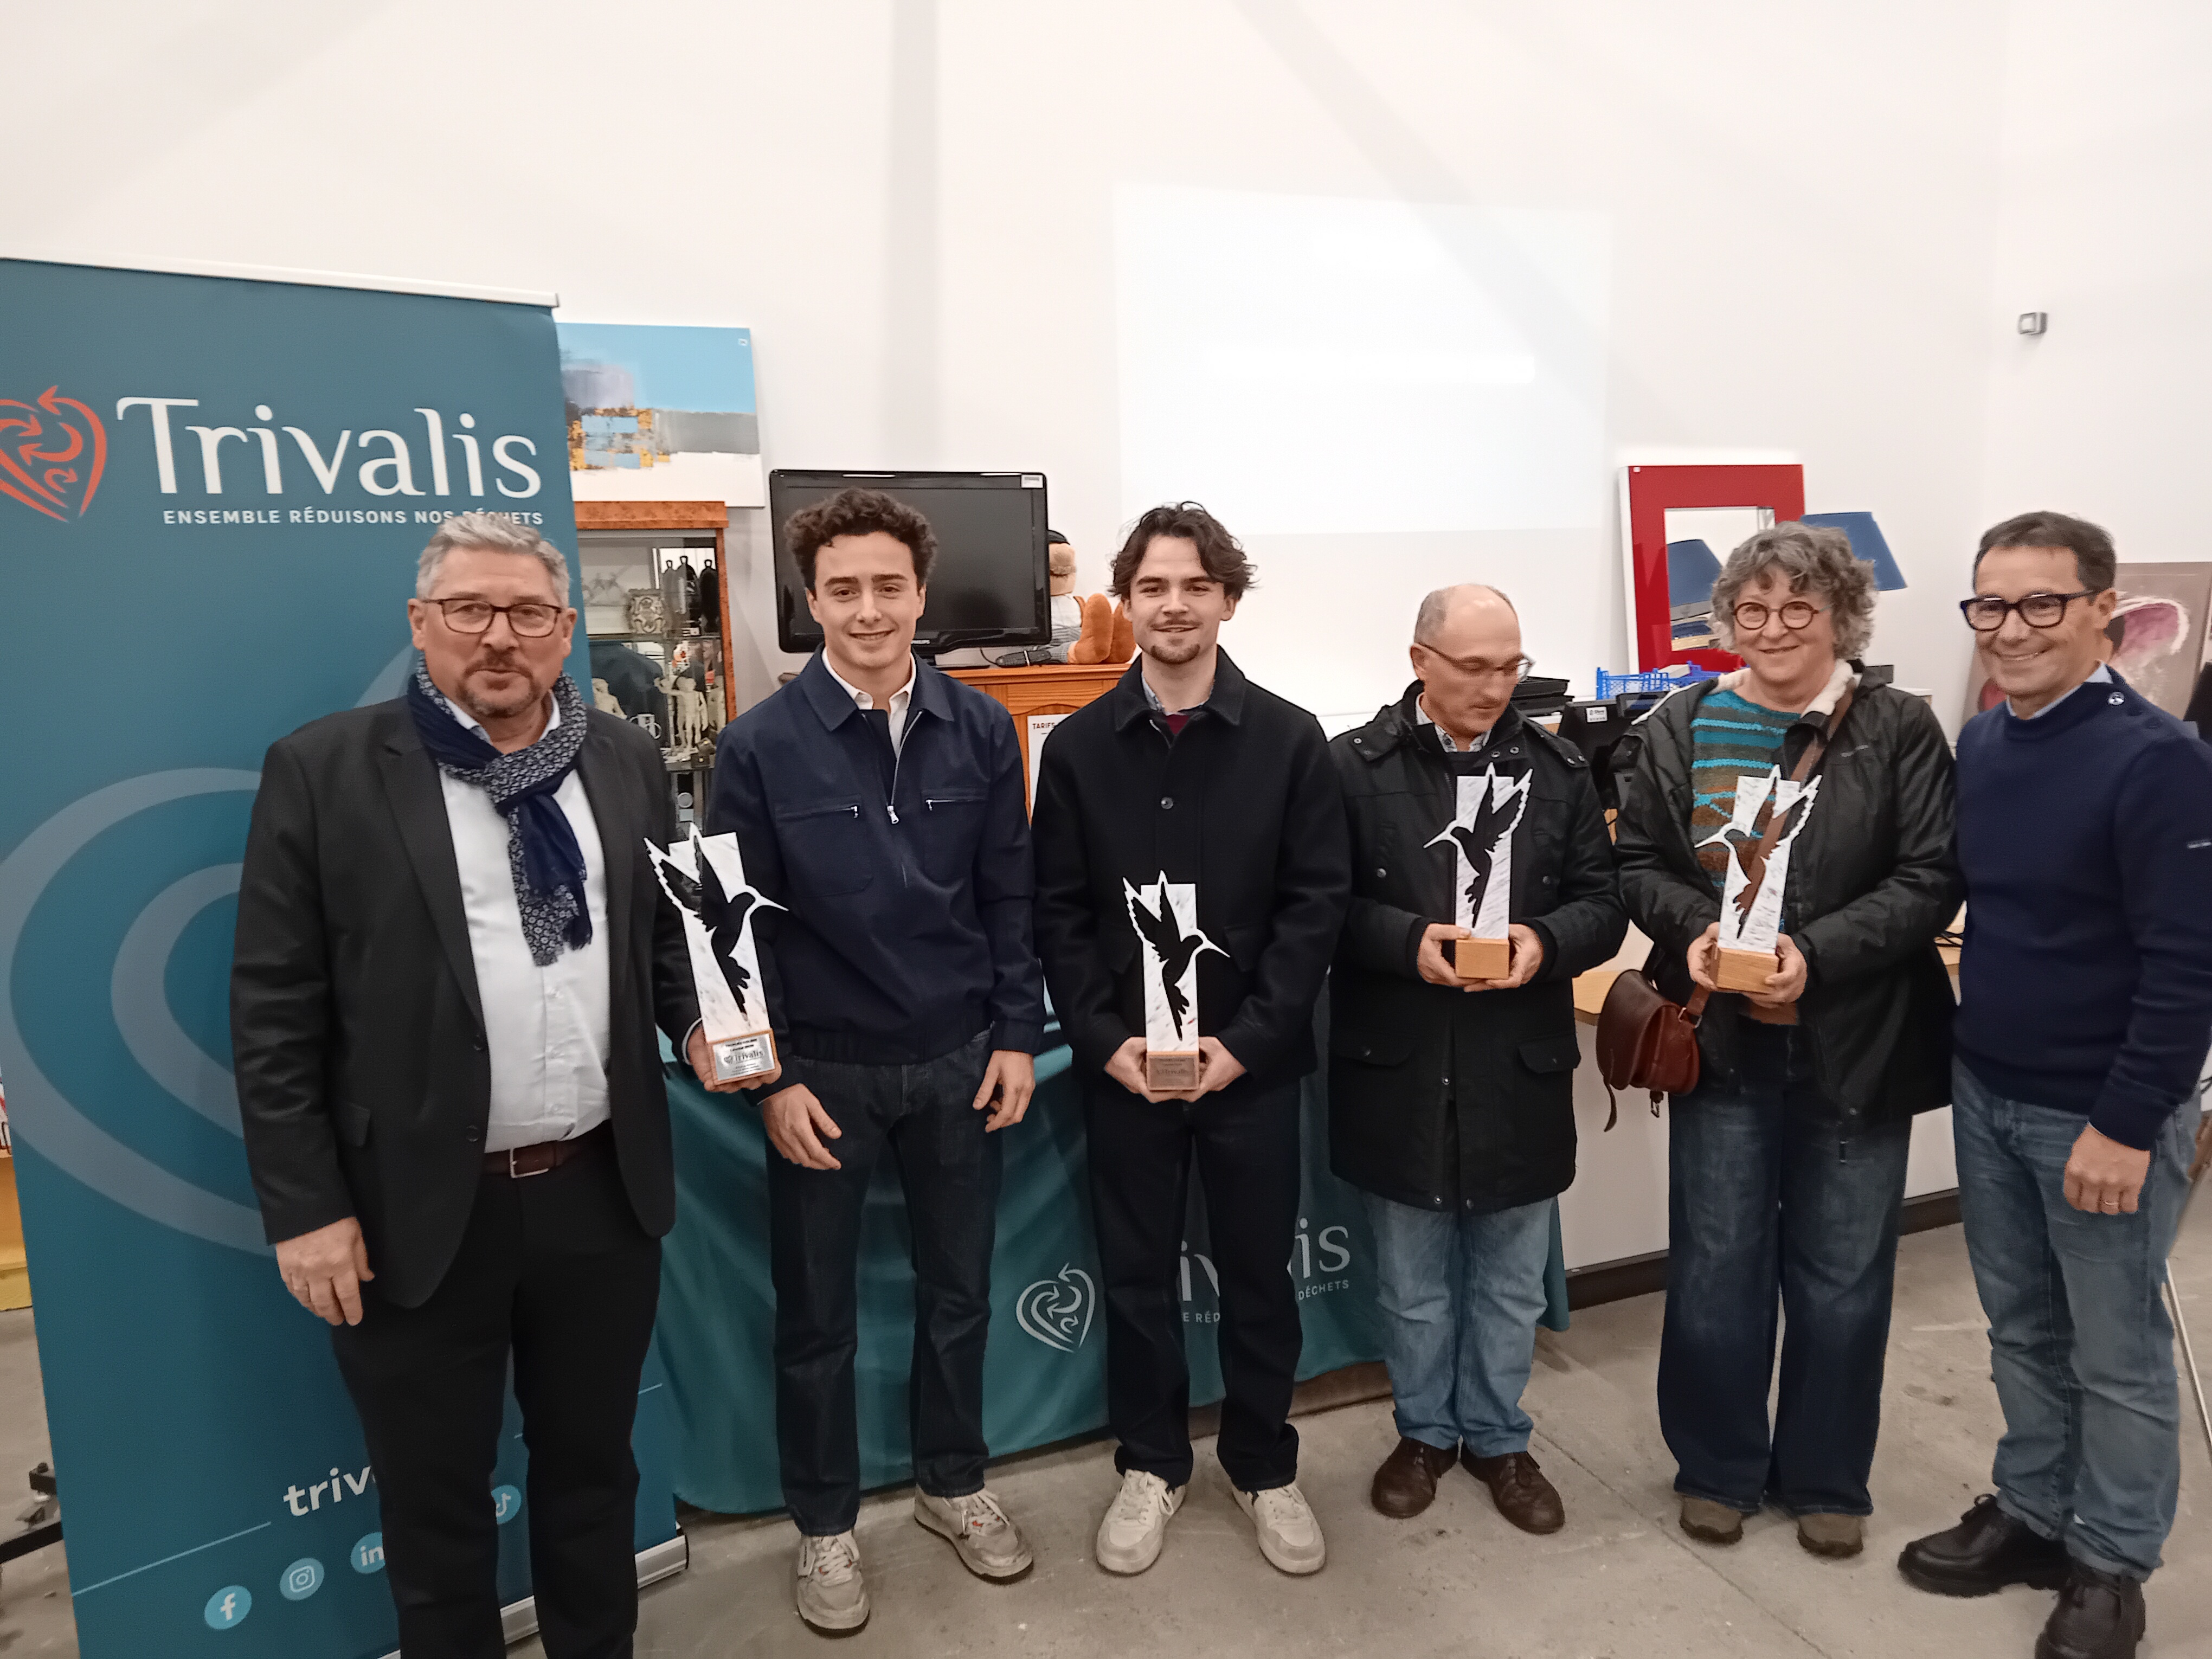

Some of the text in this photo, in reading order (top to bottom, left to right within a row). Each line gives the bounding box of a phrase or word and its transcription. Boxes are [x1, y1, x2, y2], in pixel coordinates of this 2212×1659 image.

[116, 397, 542, 498] Trivalis
[163, 510, 281, 524] ENSEMBLE
[290, 506, 407, 524] RÉDUISONS
[414, 511, 454, 524] NOS
[1298, 1279, 1349, 1301] DÉCHETS
[283, 1466, 375, 1516] triv
